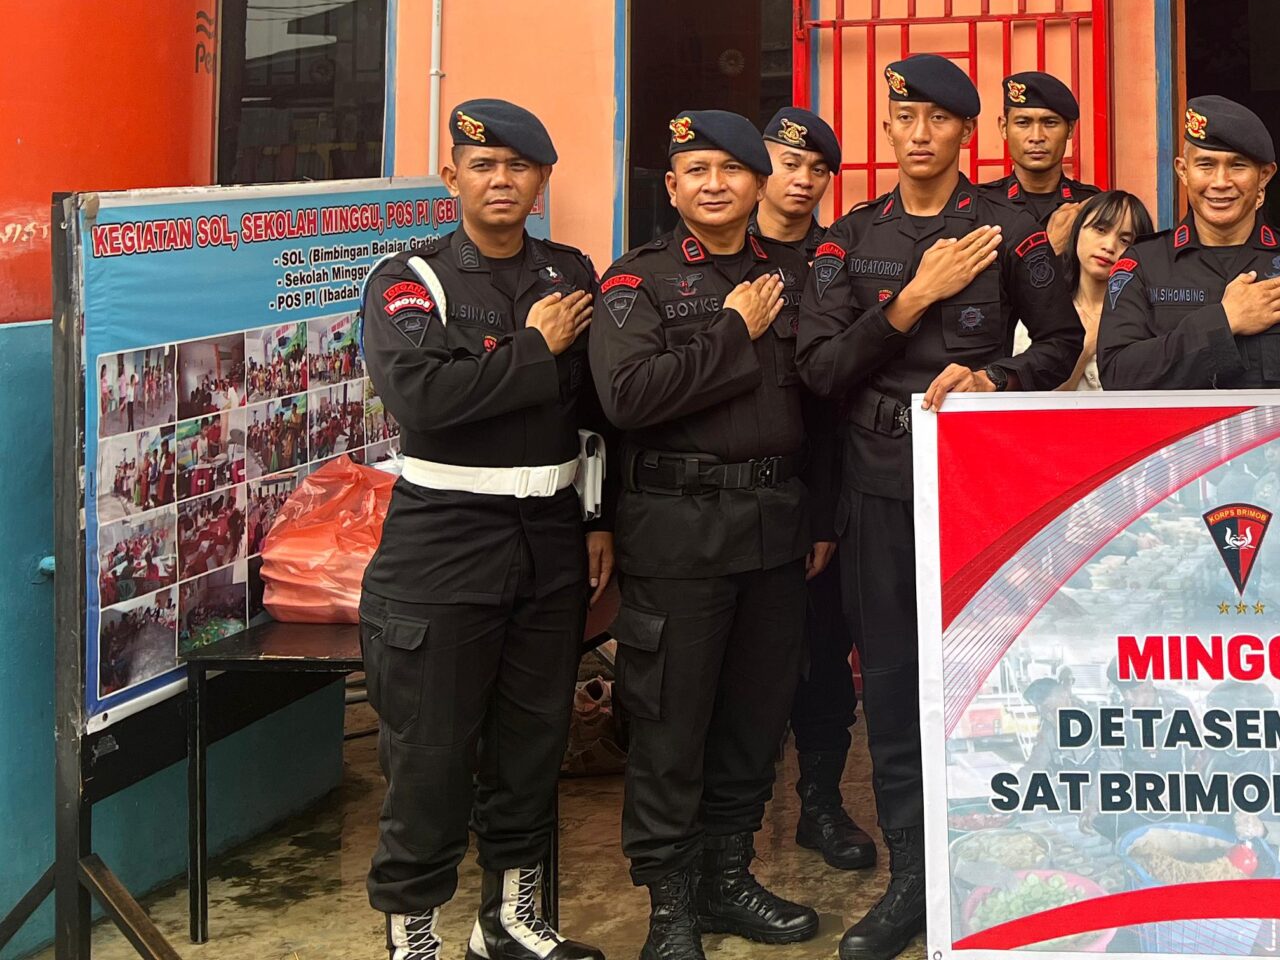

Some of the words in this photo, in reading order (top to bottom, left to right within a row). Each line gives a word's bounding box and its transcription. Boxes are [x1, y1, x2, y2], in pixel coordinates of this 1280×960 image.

[92, 218, 193, 257] KEGIATAN
[197, 215, 239, 250] SOL,
[241, 208, 319, 243] SEKOLAH
[321, 202, 384, 235] MINGGU,
[386, 200, 414, 228] POS
[416, 198, 430, 225] PI
[432, 197, 458, 229] (GBI
[281, 251, 305, 267] SOL
[309, 245, 369, 266] (Bimbingan
[285, 270, 329, 288] Sekolah
[332, 265, 370, 282] Minggu
[277, 292, 301, 310] POS
[305, 291, 316, 305] PI
[319, 285, 360, 307] (Ibadah
[665, 297, 720, 319] BOYKE
[1208, 509, 1235, 523] KORPS
[1236, 508, 1268, 521] BRIMOB
[990, 772, 1090, 812] SAT
